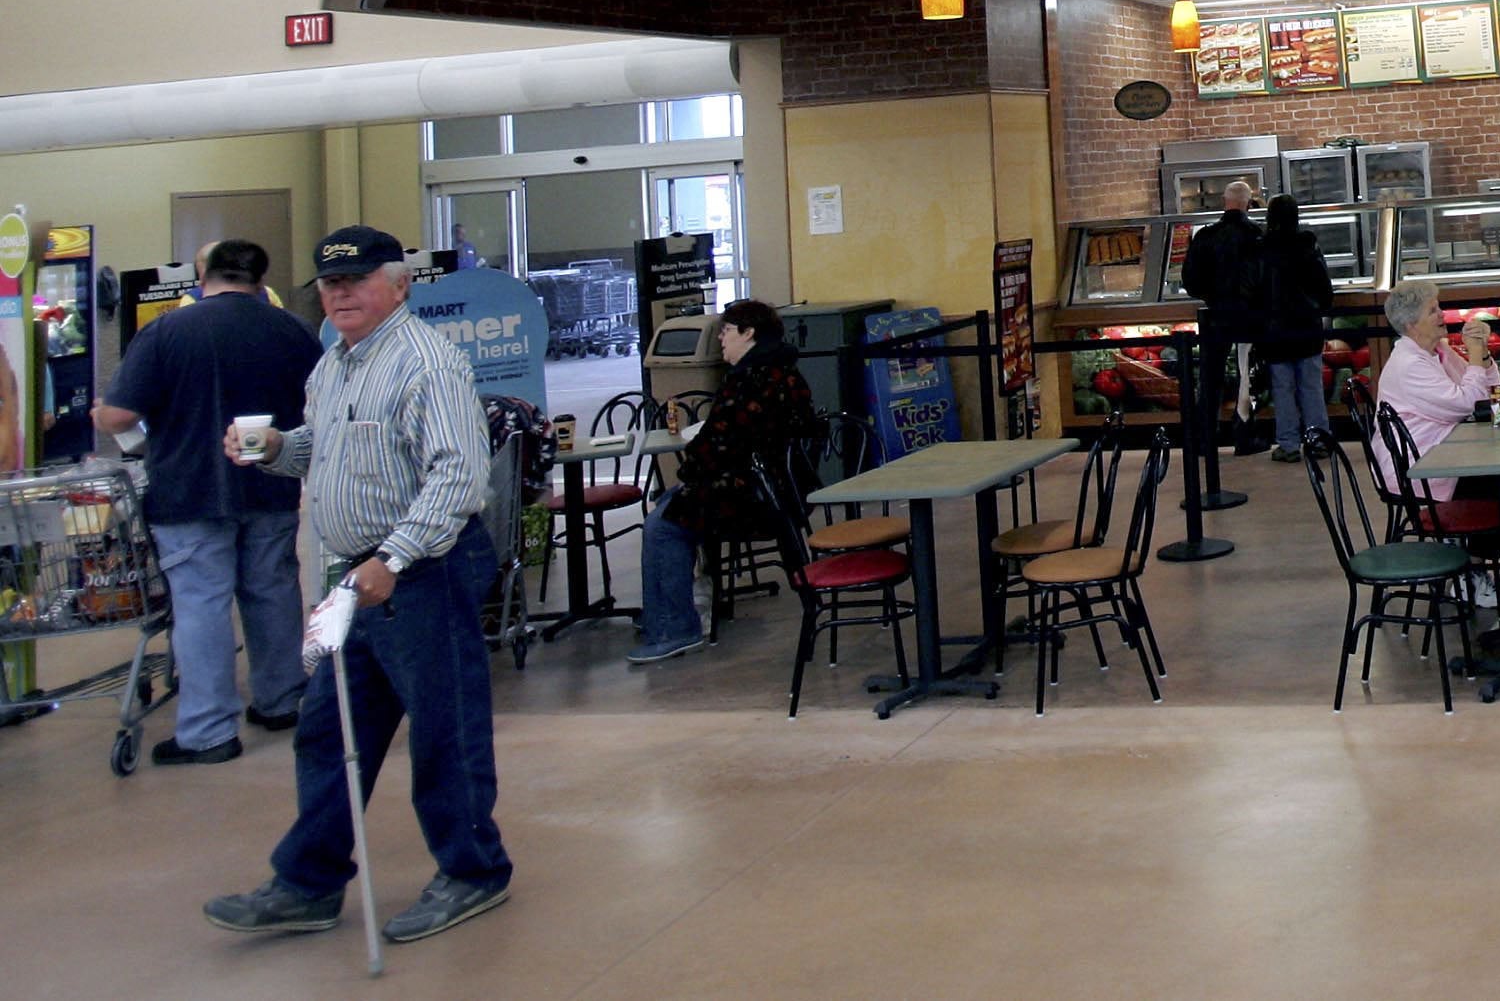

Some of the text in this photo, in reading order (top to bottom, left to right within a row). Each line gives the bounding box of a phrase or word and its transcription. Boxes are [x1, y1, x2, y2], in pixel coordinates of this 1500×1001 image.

[293, 16, 324, 43] EXIT
[477, 335, 529, 360] here!
[891, 398, 950, 430] Kids'
[901, 425, 947, 453] Pak
